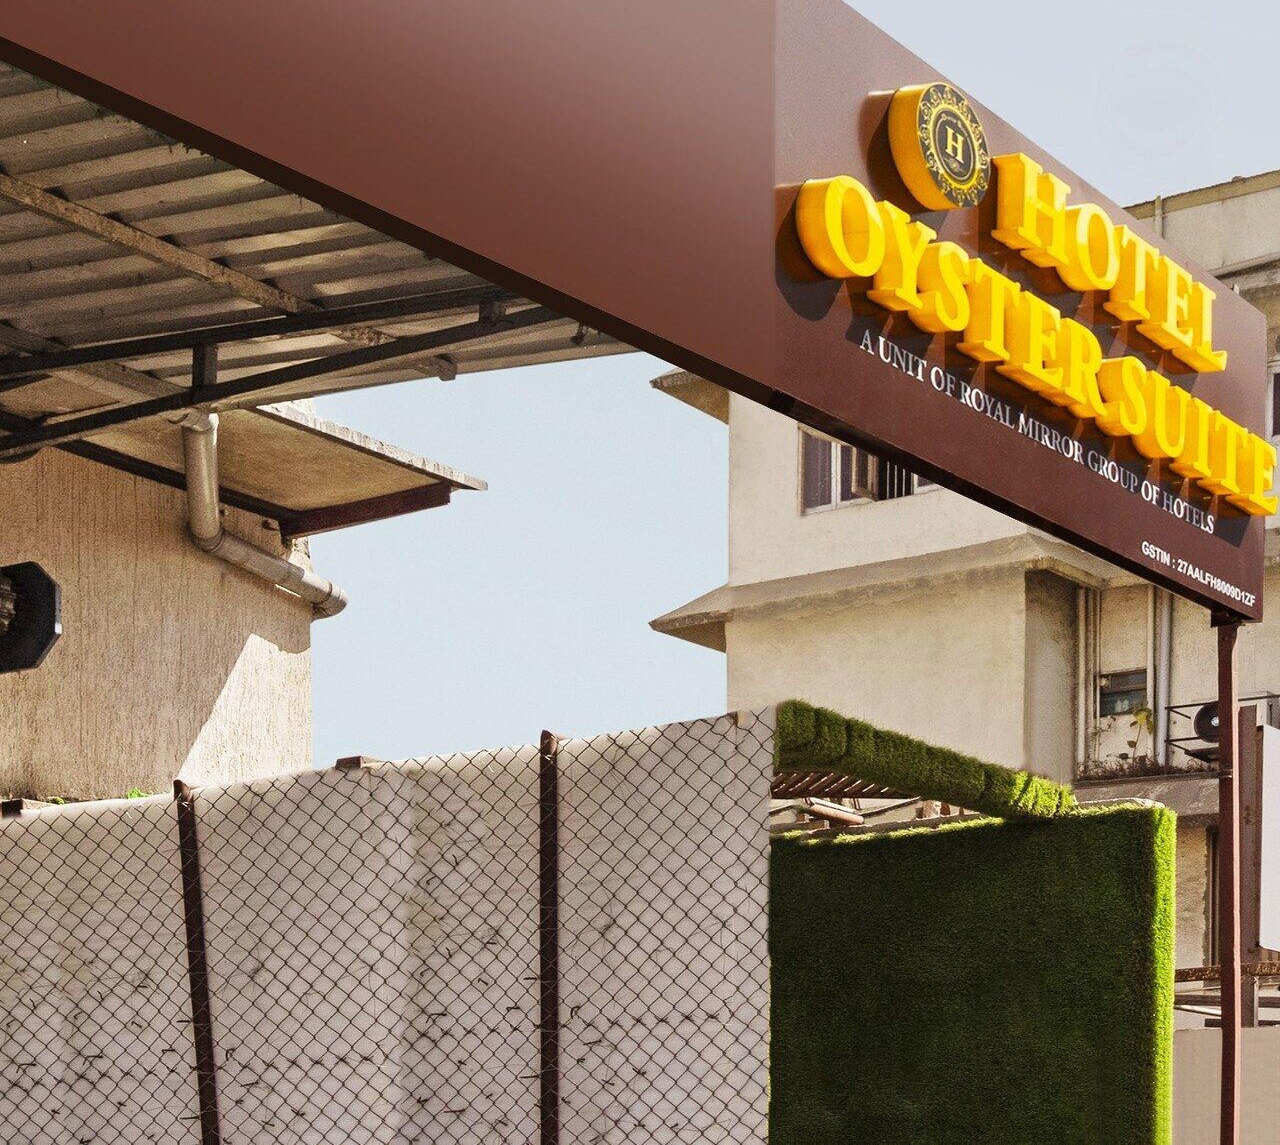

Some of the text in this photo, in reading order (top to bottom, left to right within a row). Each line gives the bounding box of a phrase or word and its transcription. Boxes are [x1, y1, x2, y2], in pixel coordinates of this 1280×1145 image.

[796, 175, 1279, 516] OYSTER SUITE
[991, 152, 1228, 373] HOTEL
[859, 329, 1216, 535] A UNIT OF ROYAL MIRROR GROUP OF HOTELS
[1141, 540, 1171, 567] GSTIN
